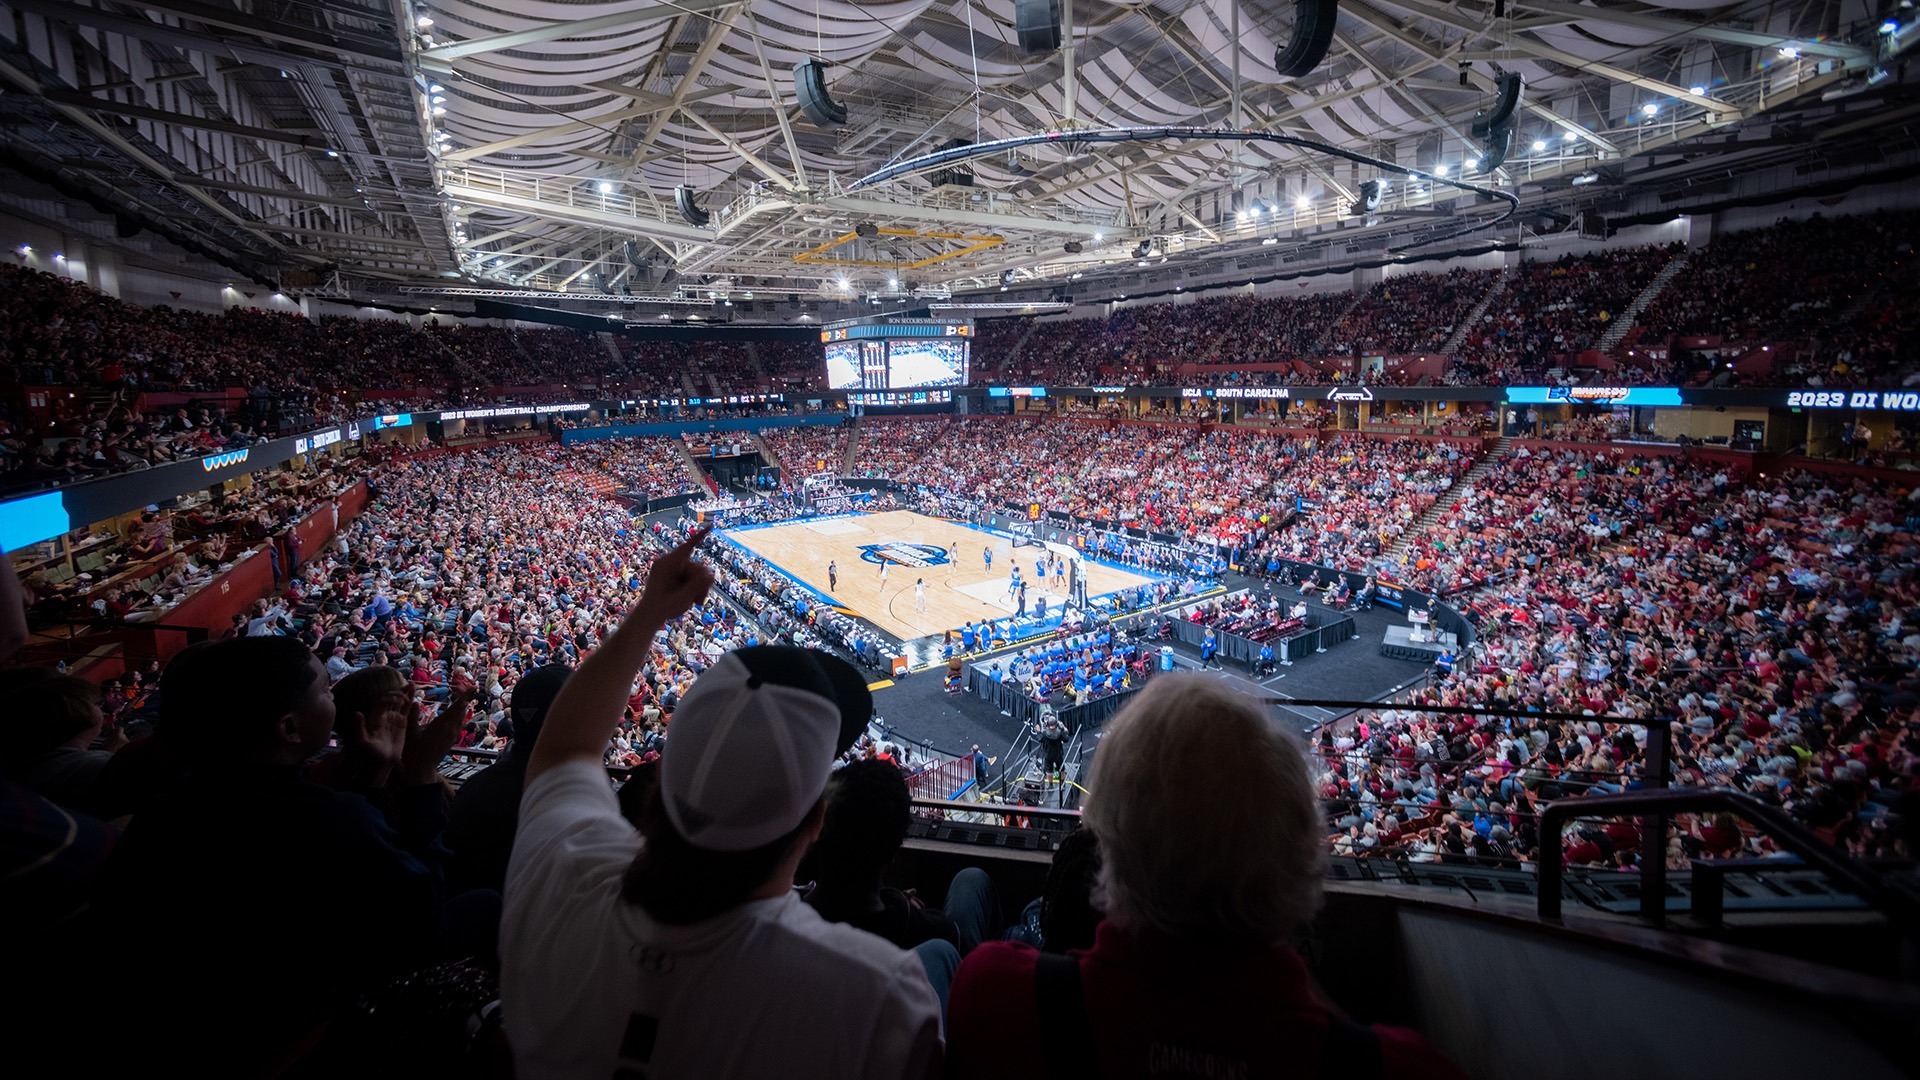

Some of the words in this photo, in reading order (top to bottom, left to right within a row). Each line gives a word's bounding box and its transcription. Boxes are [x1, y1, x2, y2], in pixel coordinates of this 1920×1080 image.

[1182, 388, 1201, 397] UCLA
[1216, 388, 1242, 398] SOUTH
[1244, 388, 1289, 398] CAROLINA
[1786, 391, 1845, 408] 2023
[1849, 392, 1878, 409] DI
[495, 405, 535, 415] BASKETBALL
[536, 403, 590, 413] CHAMPIONSHIP
